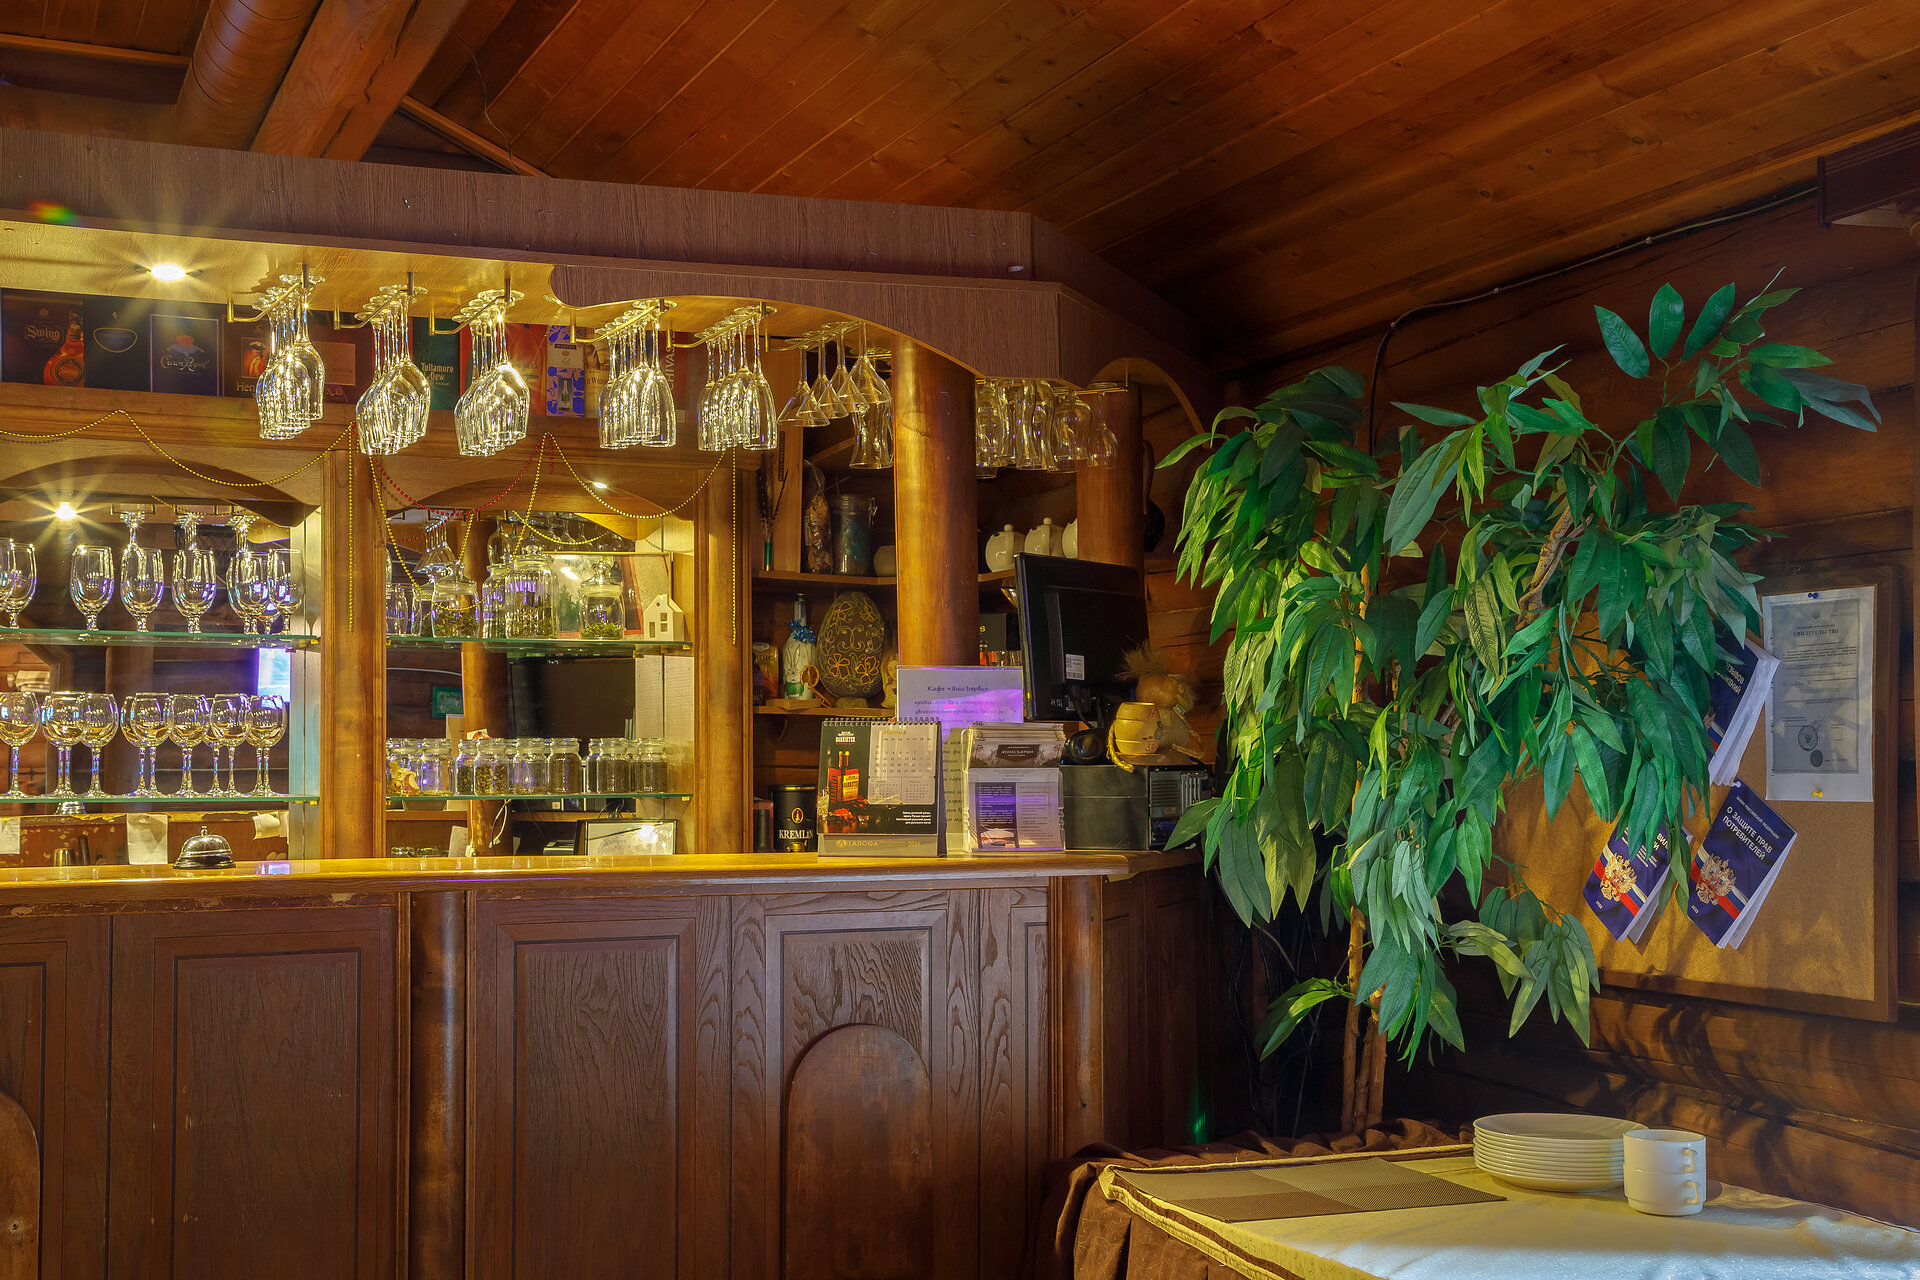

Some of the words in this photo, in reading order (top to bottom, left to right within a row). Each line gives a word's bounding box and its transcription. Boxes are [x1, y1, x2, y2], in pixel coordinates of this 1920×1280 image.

[26, 325, 60, 341] Swing
[421, 362, 454, 373] Tullamore
[430, 373, 445, 381] Dew
[1722, 815, 1766, 860] ПОТРЕБИТЕЛЕЙ
[1726, 806, 1733, 814] О
[1732, 811, 1757, 838] ЗАЩИТЕ
[1755, 835, 1773, 853] ПРАВ
